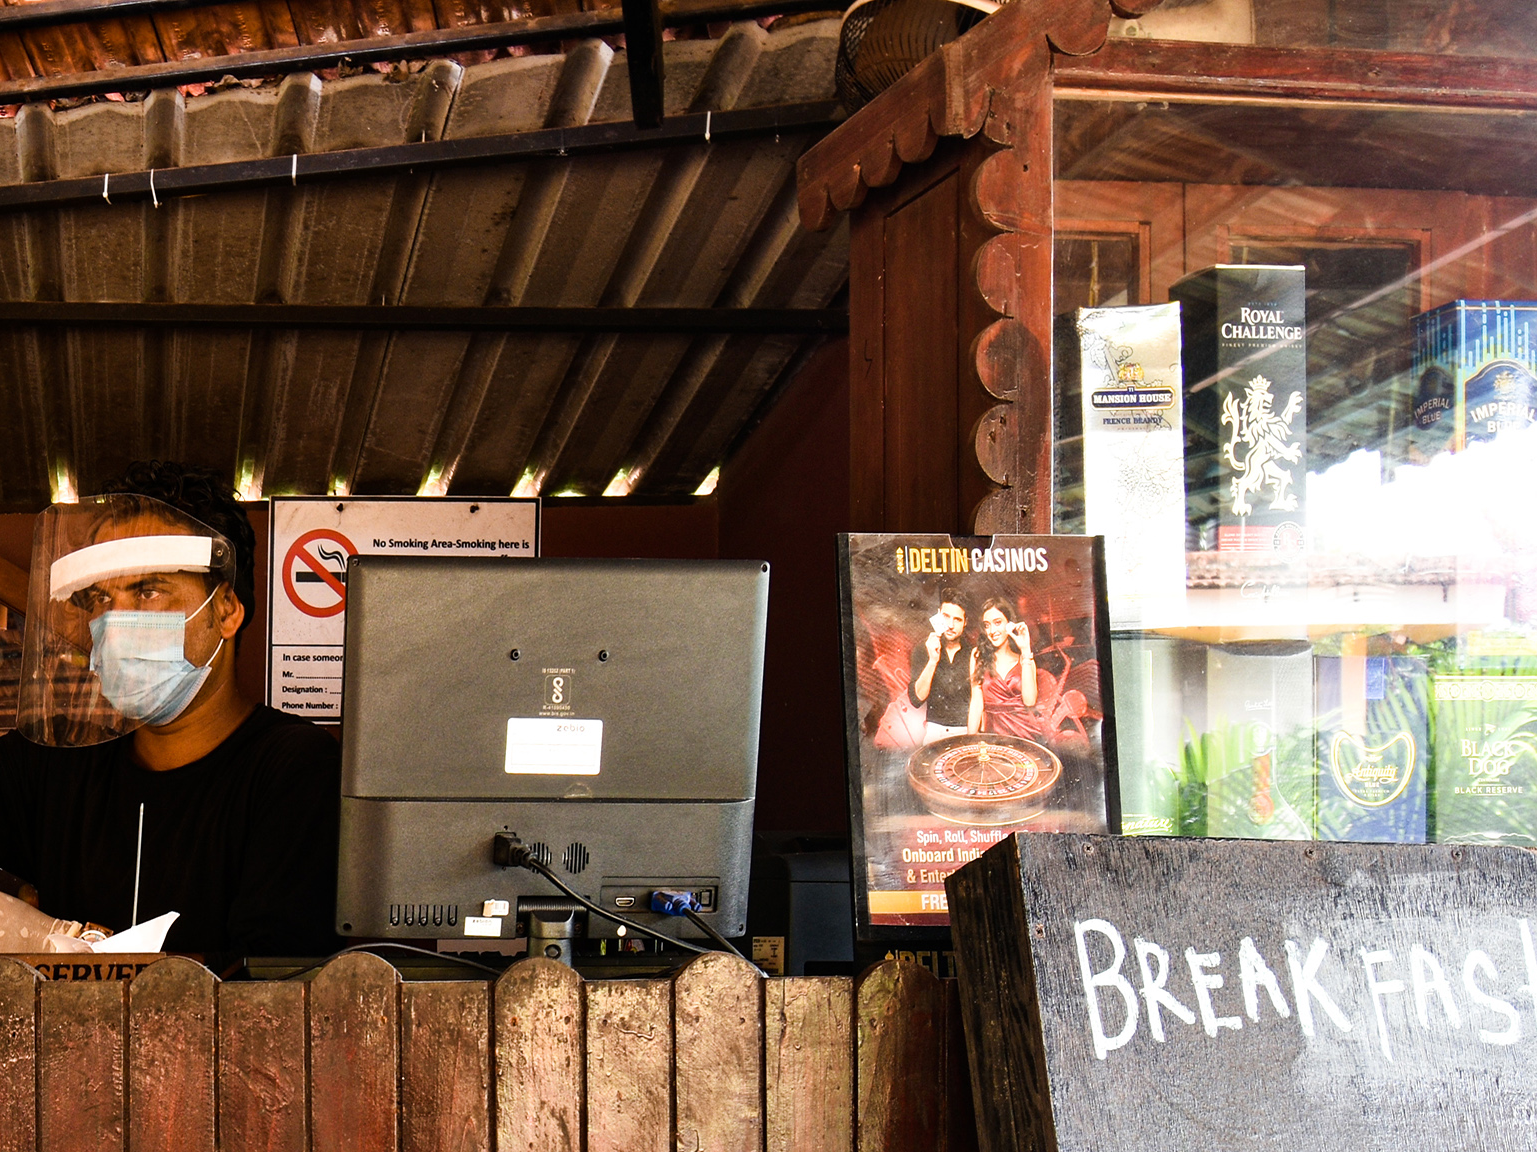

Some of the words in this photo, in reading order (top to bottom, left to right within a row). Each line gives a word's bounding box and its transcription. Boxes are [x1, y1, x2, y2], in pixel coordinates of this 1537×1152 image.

[1241, 307, 1284, 325] ROYAL
[1221, 322, 1303, 340] CHALLENGE
[1093, 394, 1137, 404] MANSION
[1139, 393, 1171, 402] HOUSE
[1414, 398, 1450, 419] IMPERIAL
[1470, 401, 1536, 423] IMPERIAL
[1133, 416, 1163, 424] BRANDY
[1423, 410, 1441, 424] BLUE
[373, 538, 386, 548] No
[389, 538, 429, 550] Smoking
[431, 539, 496, 551] Area-Smoking
[499, 539, 519, 549] here
[522, 540, 529, 549] is
[909, 548, 969, 573] DELTIN
[971, 547, 1049, 573] CASINOS
[282, 686, 323, 694] Designation
[1461, 739, 1516, 757] BLACK
[1345, 762, 1399, 784] Antiquity
[1469, 758, 1510, 776] DOG
[1485, 786, 1523, 794] RESERVE
[917, 830, 942, 846] Spin,
[945, 830, 968, 844] Roll,
[970, 830, 1008, 843] Shuffle
[902, 848, 954, 863] Onboard
[907, 869, 916, 884] &
[921, 869, 955, 883] Ente
